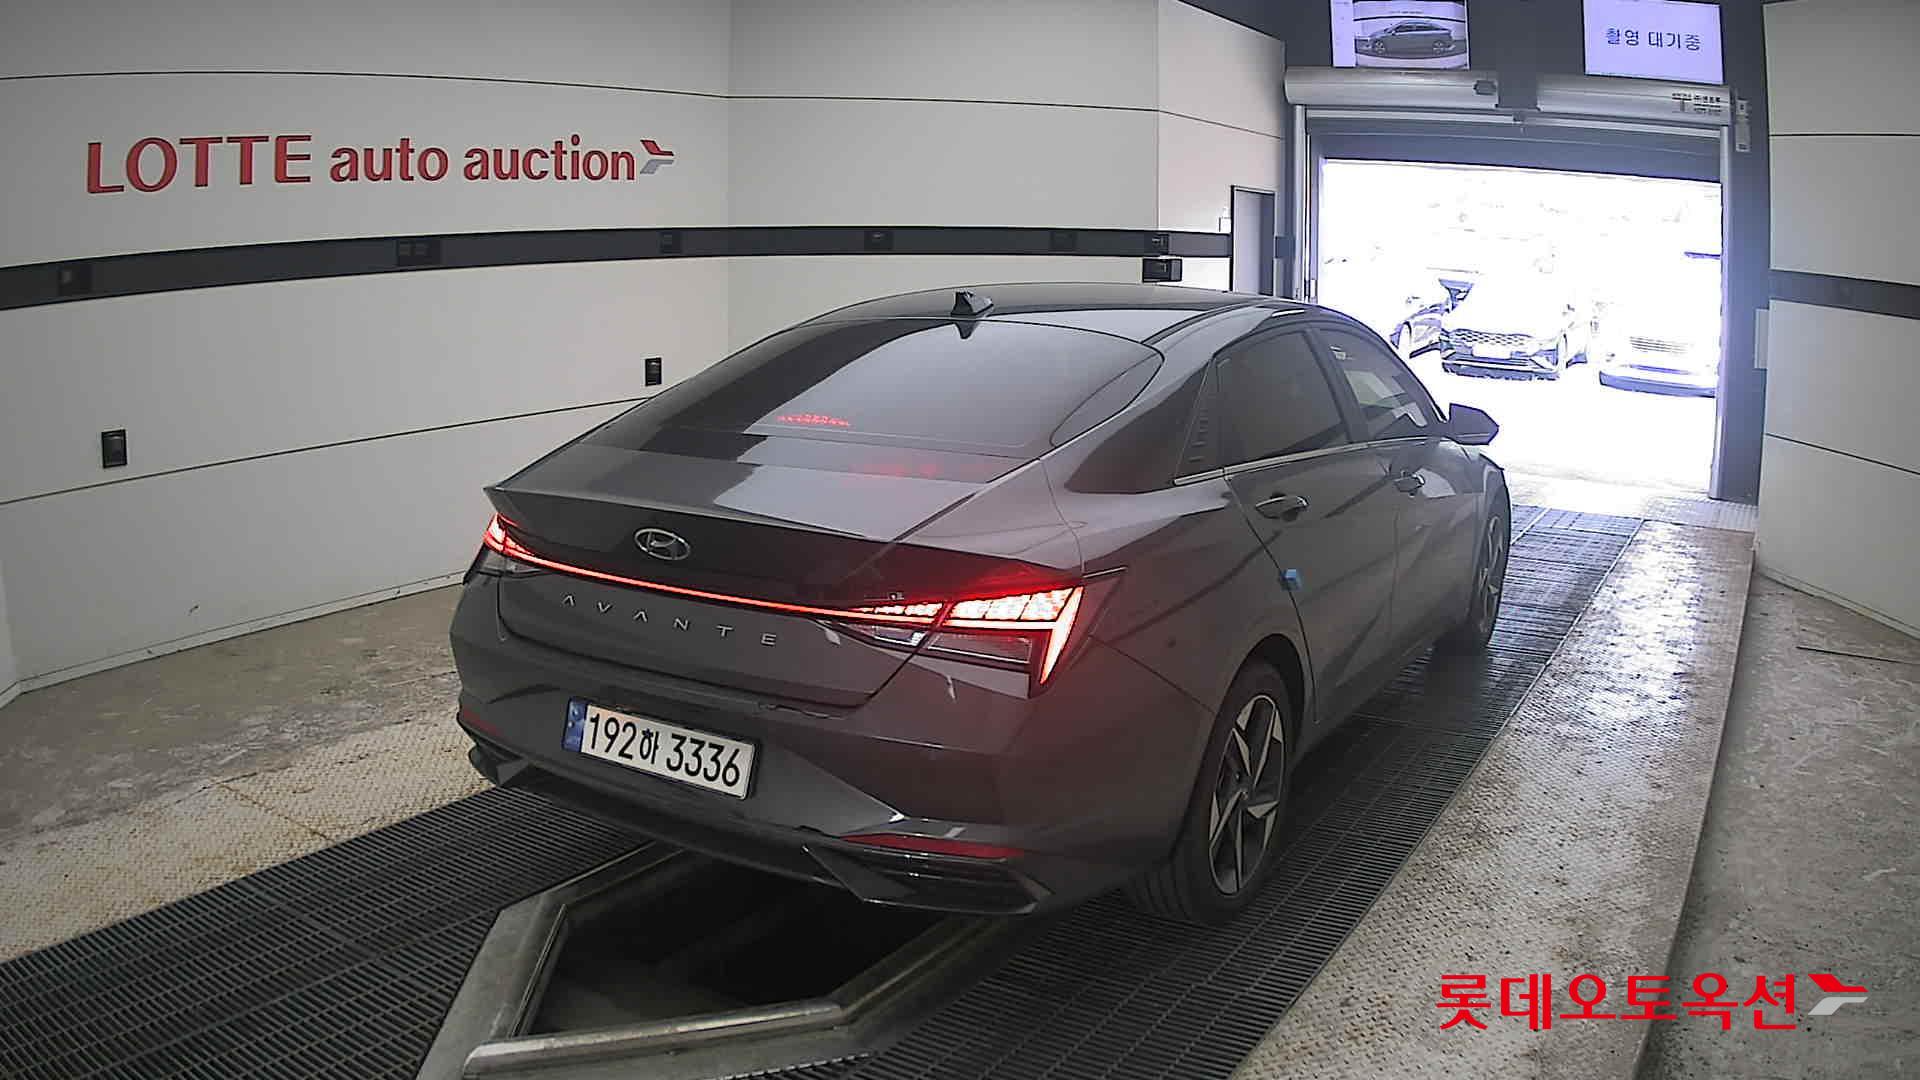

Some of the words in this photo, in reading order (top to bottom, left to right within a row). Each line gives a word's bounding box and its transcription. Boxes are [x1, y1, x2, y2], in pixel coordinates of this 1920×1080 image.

[1606, 27, 1640, 47] 촬영
[1647, 31, 1701, 51] 대기중
[87, 135, 312, 193] LOTTE
[330, 138, 450, 182] auto
[464, 135, 636, 181] auction
[563, 594, 777, 646] AVANTE
[666, 733, 740, 787] 3336
